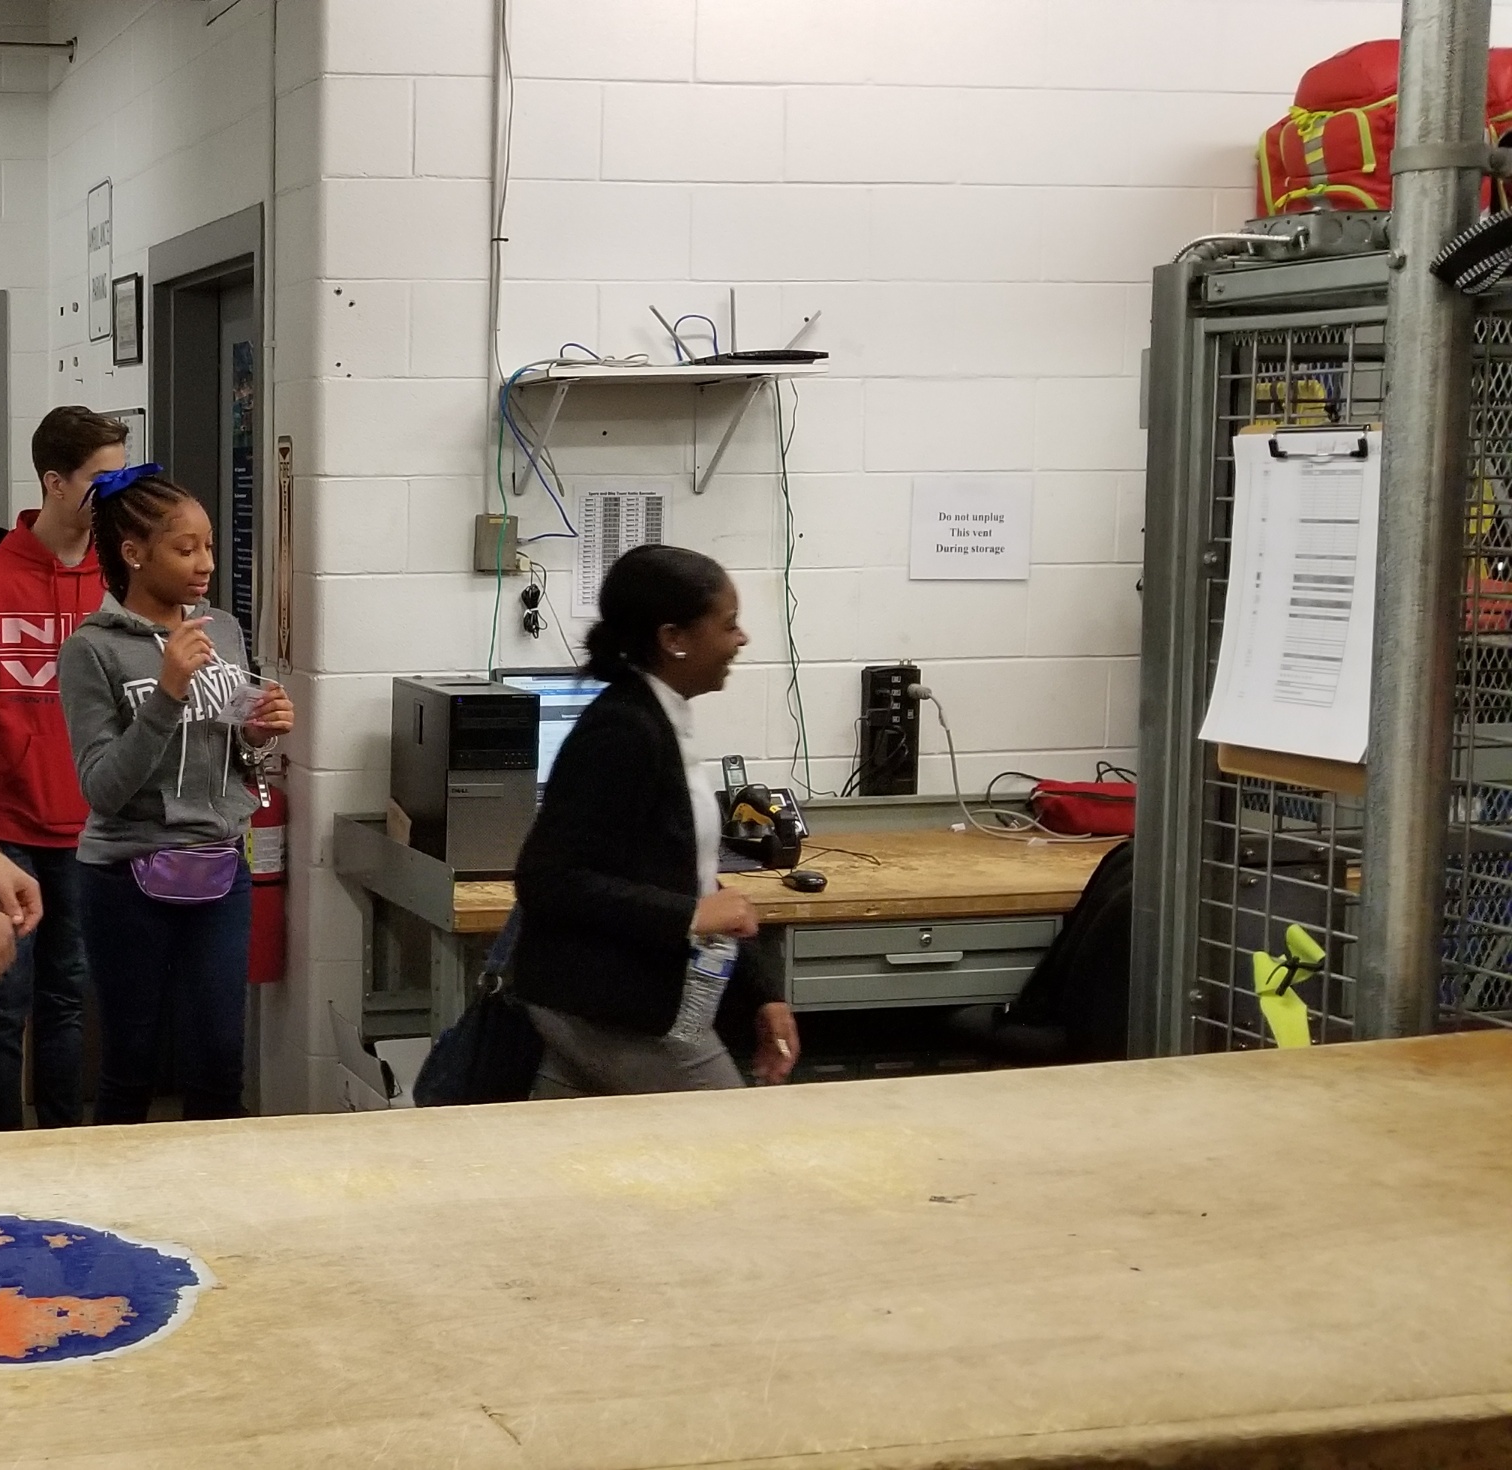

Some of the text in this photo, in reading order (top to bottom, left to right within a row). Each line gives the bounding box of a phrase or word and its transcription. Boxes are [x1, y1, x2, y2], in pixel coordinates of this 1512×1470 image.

[938, 511, 1005, 524] Do not unplug
[950, 527, 992, 537] This vent
[935, 543, 1005, 555] During storage
